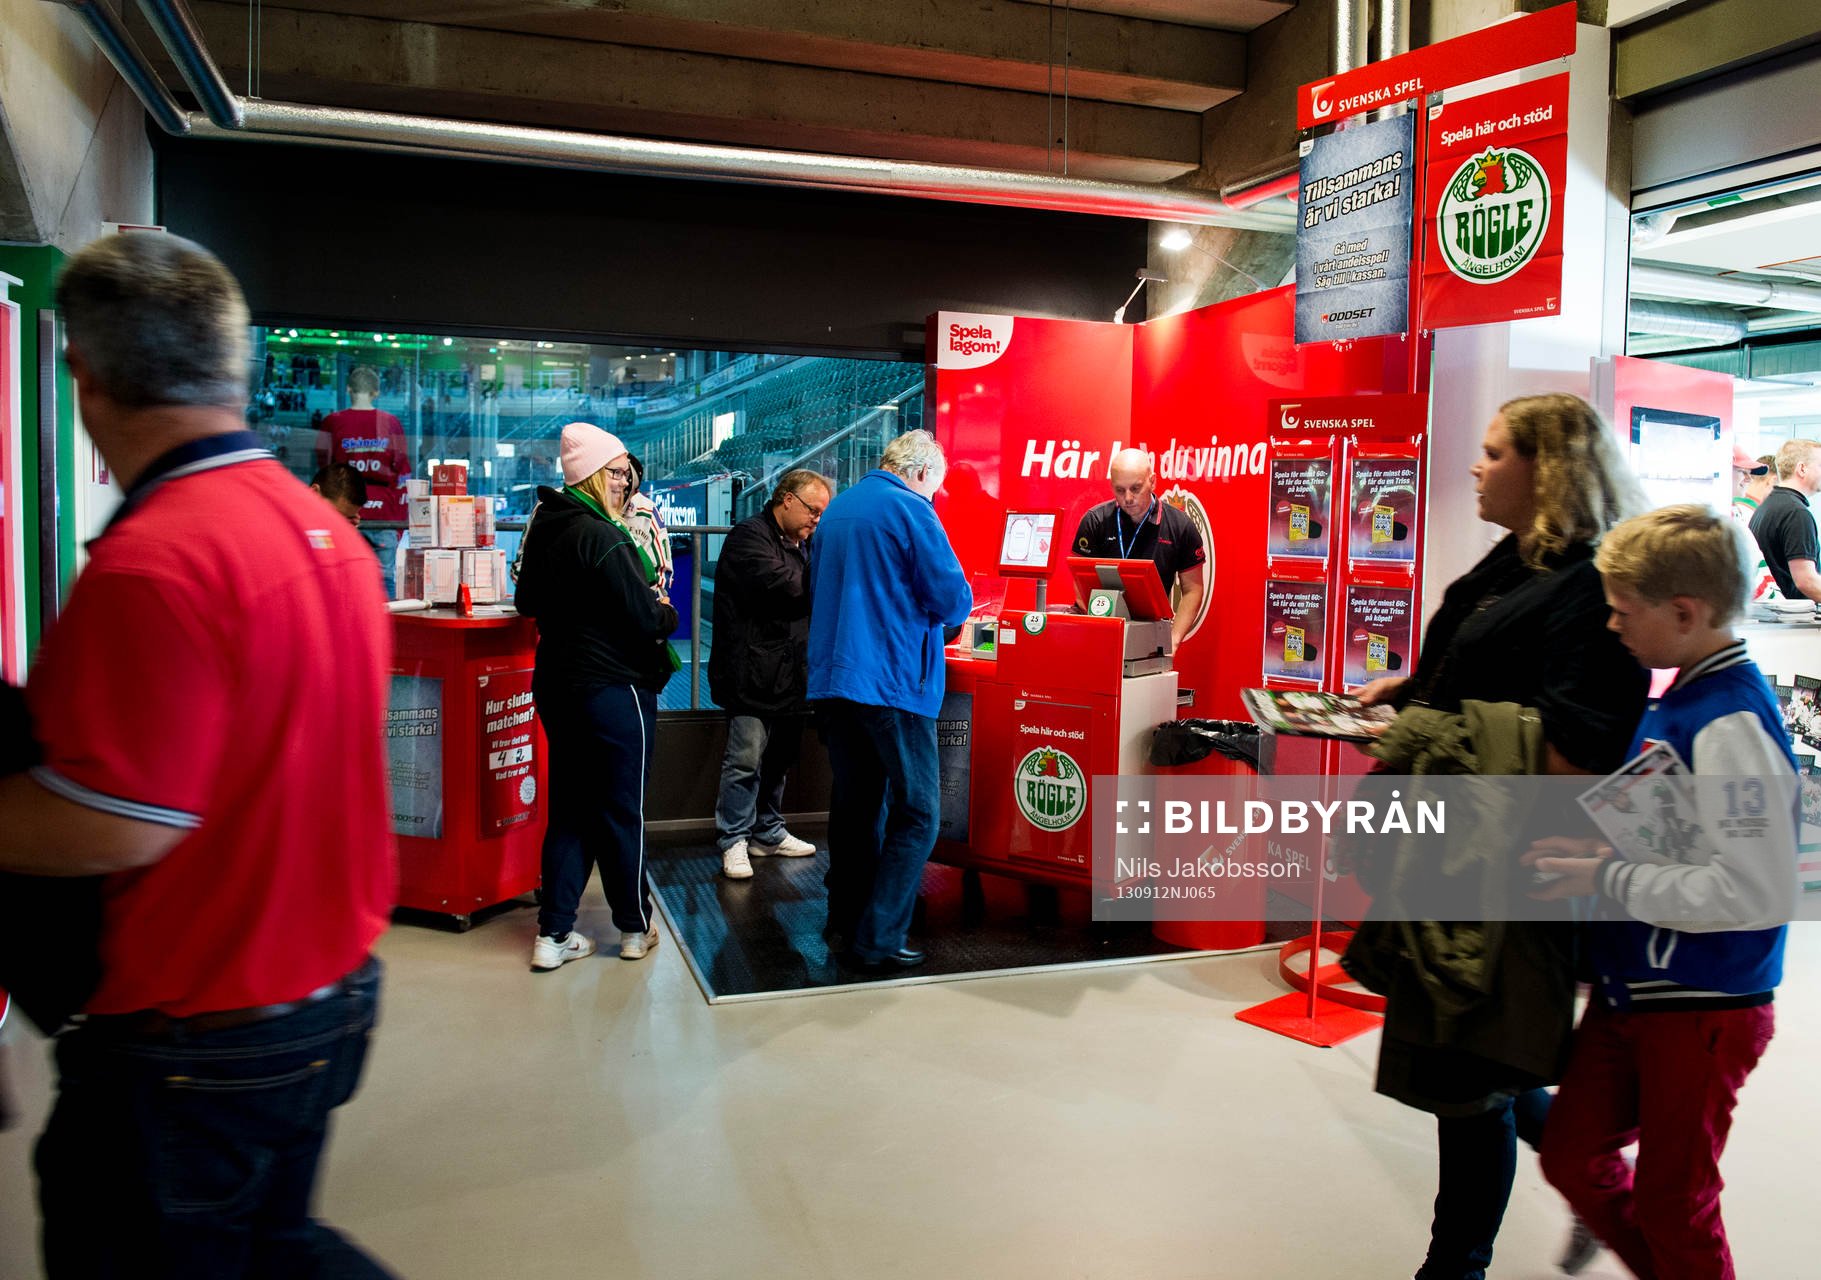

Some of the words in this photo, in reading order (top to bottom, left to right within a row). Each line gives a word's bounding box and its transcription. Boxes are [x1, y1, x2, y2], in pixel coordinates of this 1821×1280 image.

[1338, 88, 1391, 113] SVENSKA
[1394, 77, 1424, 97] SPEL
[1440, 128, 1473, 147] Spela
[1475, 121, 1496, 137] här
[1498, 115, 1521, 132] och
[1523, 105, 1553, 126] stöd
[1303, 151, 1403, 204] Tillsammans
[1303, 206, 1322, 229] är
[1324, 198, 1339, 221] vi
[1341, 174, 1401, 215] starka!
[1455, 199, 1534, 260] RÖGLE
[1334, 242, 1347, 256] Gå
[1347, 238, 1369, 254] med
[1313, 262, 1318, 274] i
[1320, 259, 1337, 273] vårt
[1337, 249, 1389, 269] andelsspel!
[1461, 245, 1526, 275] ÄNGELHOLM
[1315, 276, 1332, 289] Säg
[1333, 272, 1346, 286] till
[1351, 268, 1387, 282] kassan.
[1328, 307, 1376, 322] ODDSET
[949, 324, 992, 343] Spela
[949, 338, 1001, 356] lagom!
[1303, 418, 1349, 429] SVENSKA
[1350, 418, 1376, 428] SPEL
[1021, 439, 1101, 480] Här
[1160, 437, 1190, 479] du
[1194, 435, 1268, 478] vinna
[1030, 615, 1040, 623] 25
[485, 700, 504, 716] Hur
[387, 724, 397, 738] vi
[399, 722, 438, 737] starka!
[486, 706, 536, 734] matchen?
[1020, 724, 1040, 735] Spela
[1040, 726, 1053, 736] här
[1053, 729, 1067, 738] och
[1068, 731, 1085, 740] stöd
[497, 751, 507, 766] 4
[515, 749, 526, 763] 2
[1026, 779, 1077, 817] RÖGLE
[1722, 778, 1767, 818] 13
[1030, 809, 1073, 826] ÄNGELHOLM
